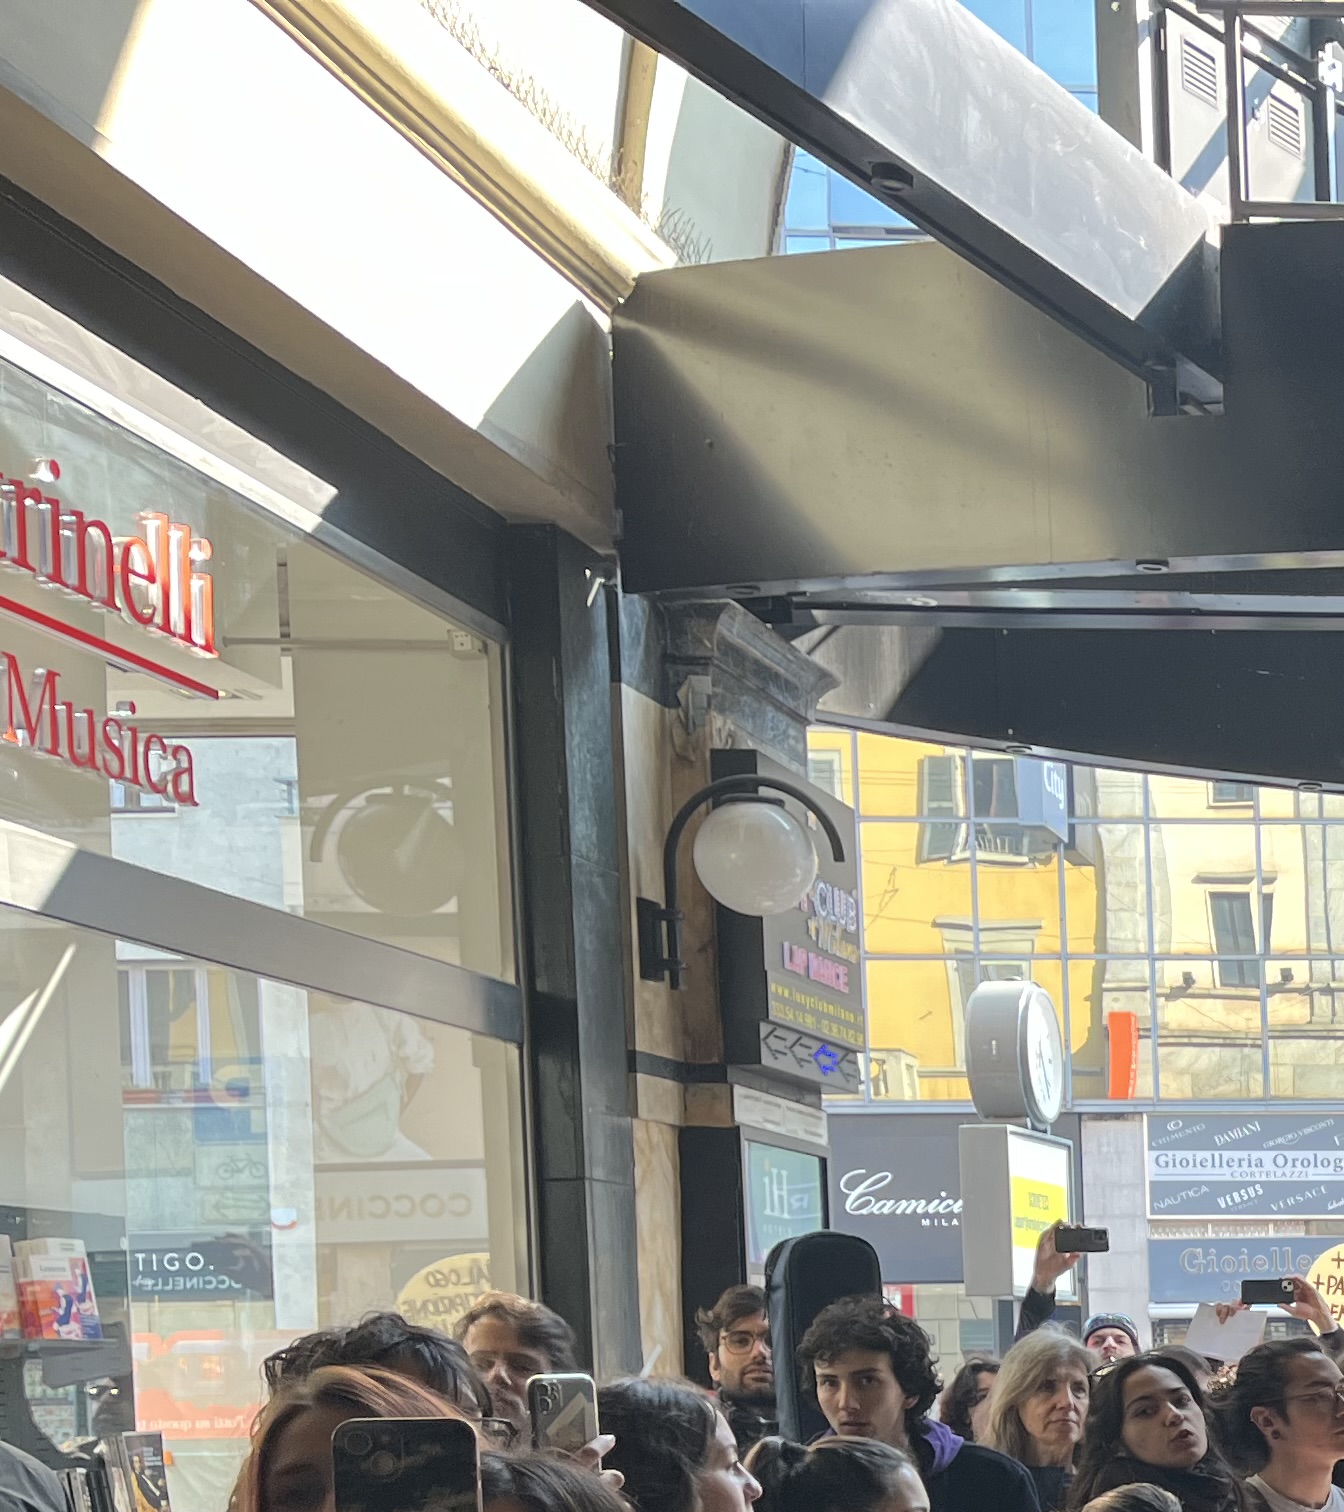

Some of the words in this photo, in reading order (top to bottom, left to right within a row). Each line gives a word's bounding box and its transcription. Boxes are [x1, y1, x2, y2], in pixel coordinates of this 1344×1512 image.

[0, 458, 219, 658] rinelli
[2, 652, 199, 807] Musica
[1044, 761, 1064, 810] City
[815, 879, 857, 933] CLUB
[782, 941, 808, 976] LAP
[808, 952, 849, 993] DANCE
[1213, 1120, 1262, 1147] DAMIANI
[1154, 1153, 1264, 1169] Gioielleria
[1230, 1170, 1310, 1180] CORTELAZZI
[1152, 1184, 1210, 1211] NAUTICA
[1216, 1183, 1264, 1209] VERSUS
[921, 1218, 959, 1227] MILA
